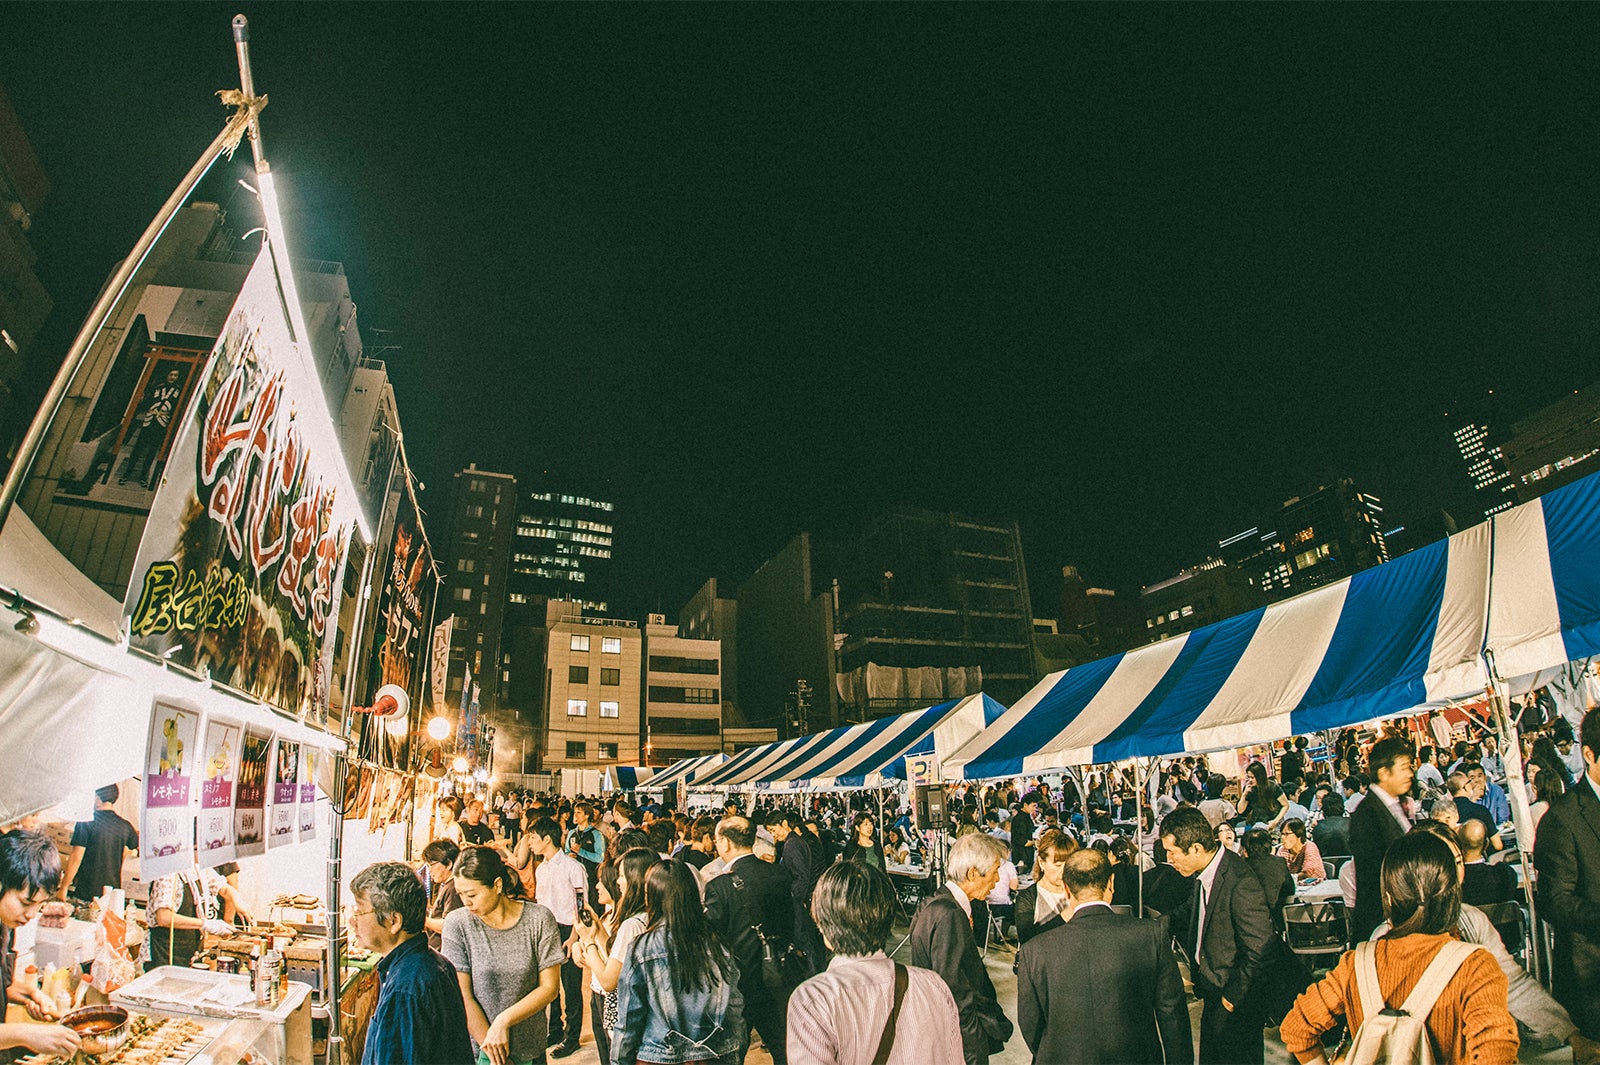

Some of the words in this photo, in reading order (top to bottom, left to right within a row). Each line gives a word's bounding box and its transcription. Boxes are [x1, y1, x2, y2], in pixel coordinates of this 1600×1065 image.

[131, 563, 251, 637] 屋台名物
[152, 784, 187, 800] レモネード
[204, 784, 220, 794] スミノフ
[211, 796, 229, 806] レモネード
[158, 818, 177, 838] ¥300
